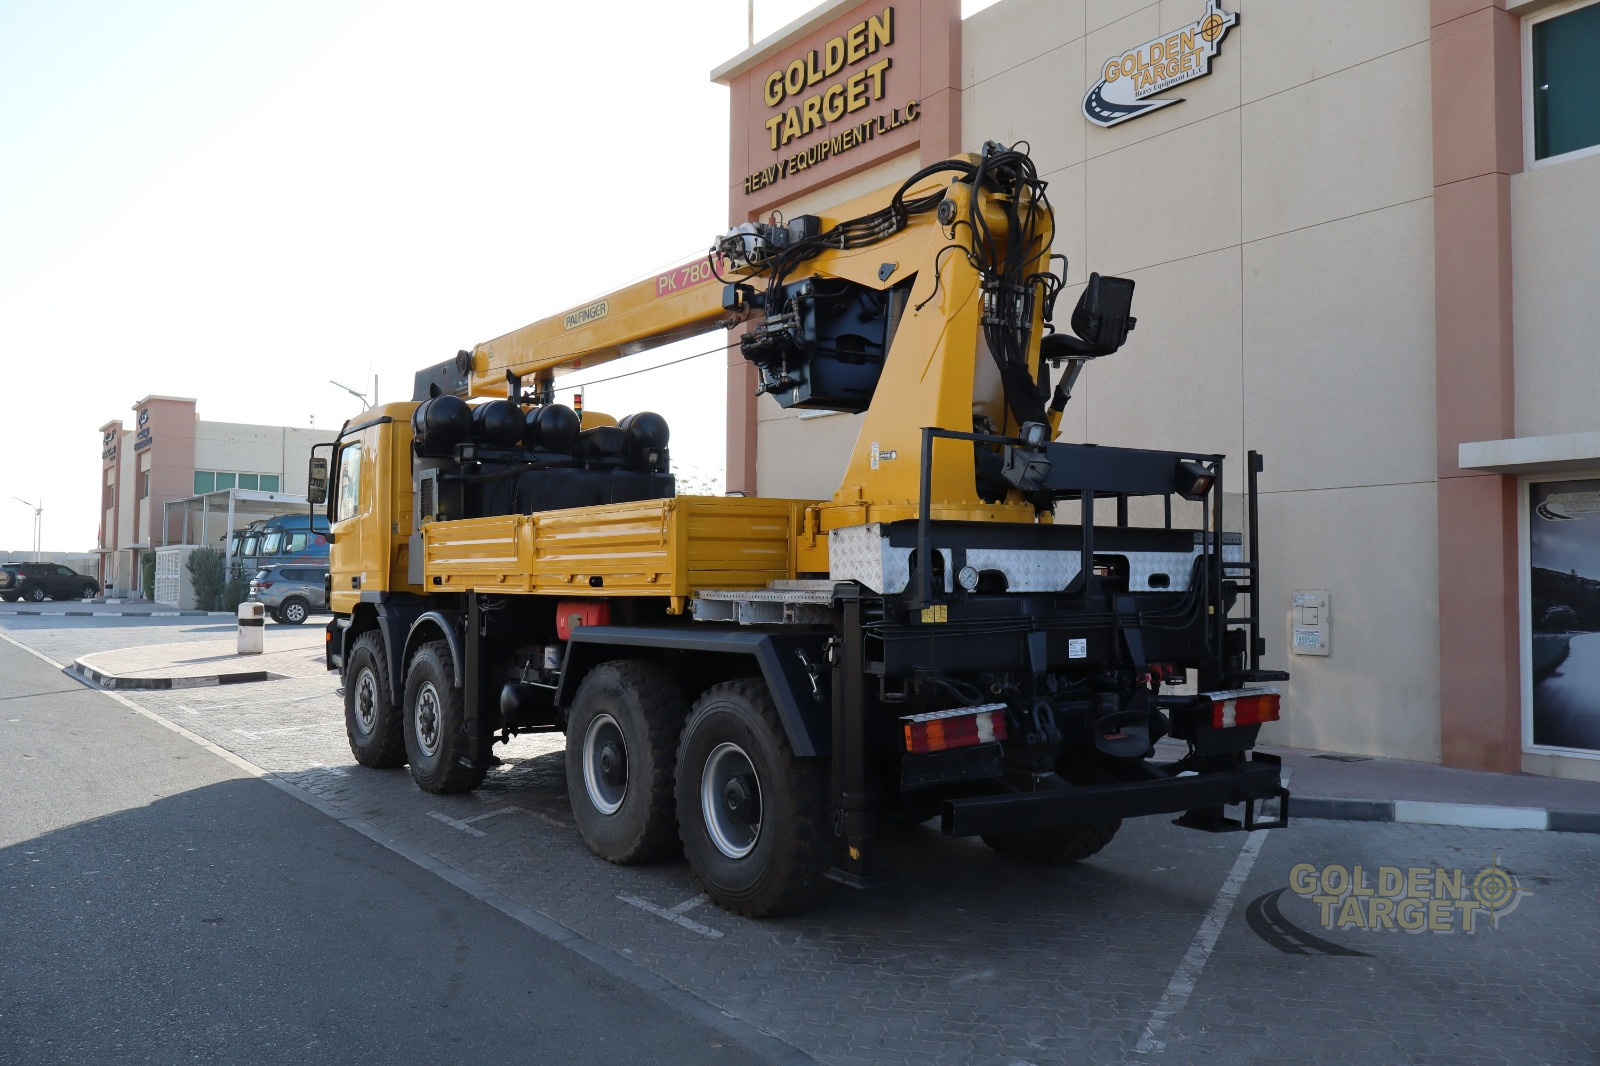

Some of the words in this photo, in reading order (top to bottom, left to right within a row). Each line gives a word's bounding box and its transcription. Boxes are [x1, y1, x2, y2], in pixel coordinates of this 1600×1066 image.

[764, 6, 894, 107] GOLDEN
[1105, 28, 1195, 83] GOLDEN
[1131, 46, 1204, 91] TARGET
[765, 57, 892, 151] TARGET
[1135, 87, 1152, 98] Heavy
[1153, 74, 1185, 91] Equipment
[743, 160, 788, 195] HEAVY
[789, 118, 876, 175] EQUIPMENT
[876, 99, 921, 135] L.L.C
[659, 271, 677, 294] PK
[566, 303, 605, 327] PALFINGER
